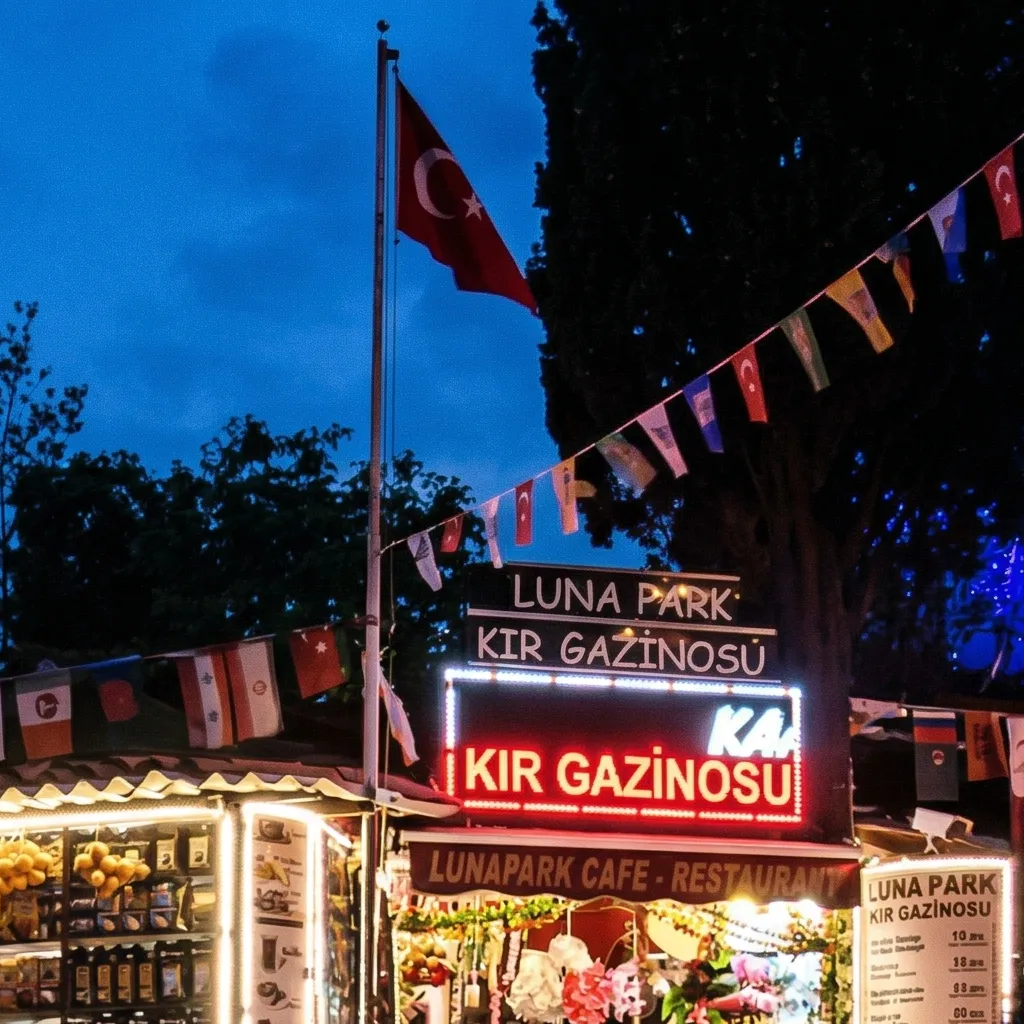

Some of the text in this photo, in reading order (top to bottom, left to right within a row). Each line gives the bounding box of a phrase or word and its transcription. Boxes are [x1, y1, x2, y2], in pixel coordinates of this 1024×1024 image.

[514, 573, 733, 621] LUNA PARK
[477, 626, 765, 676] KIR GAZİNOSU
[465, 745, 792, 806] KIR GAZİNOSU
[429, 849, 576, 889] LUNAPARK
[580, 856, 651, 892] CAFE
[670, 862, 845, 898] RESTAURANT
[868, 873, 997, 903] LUNA PARK
[869, 899, 991, 924] KIR GAZİNOSU
